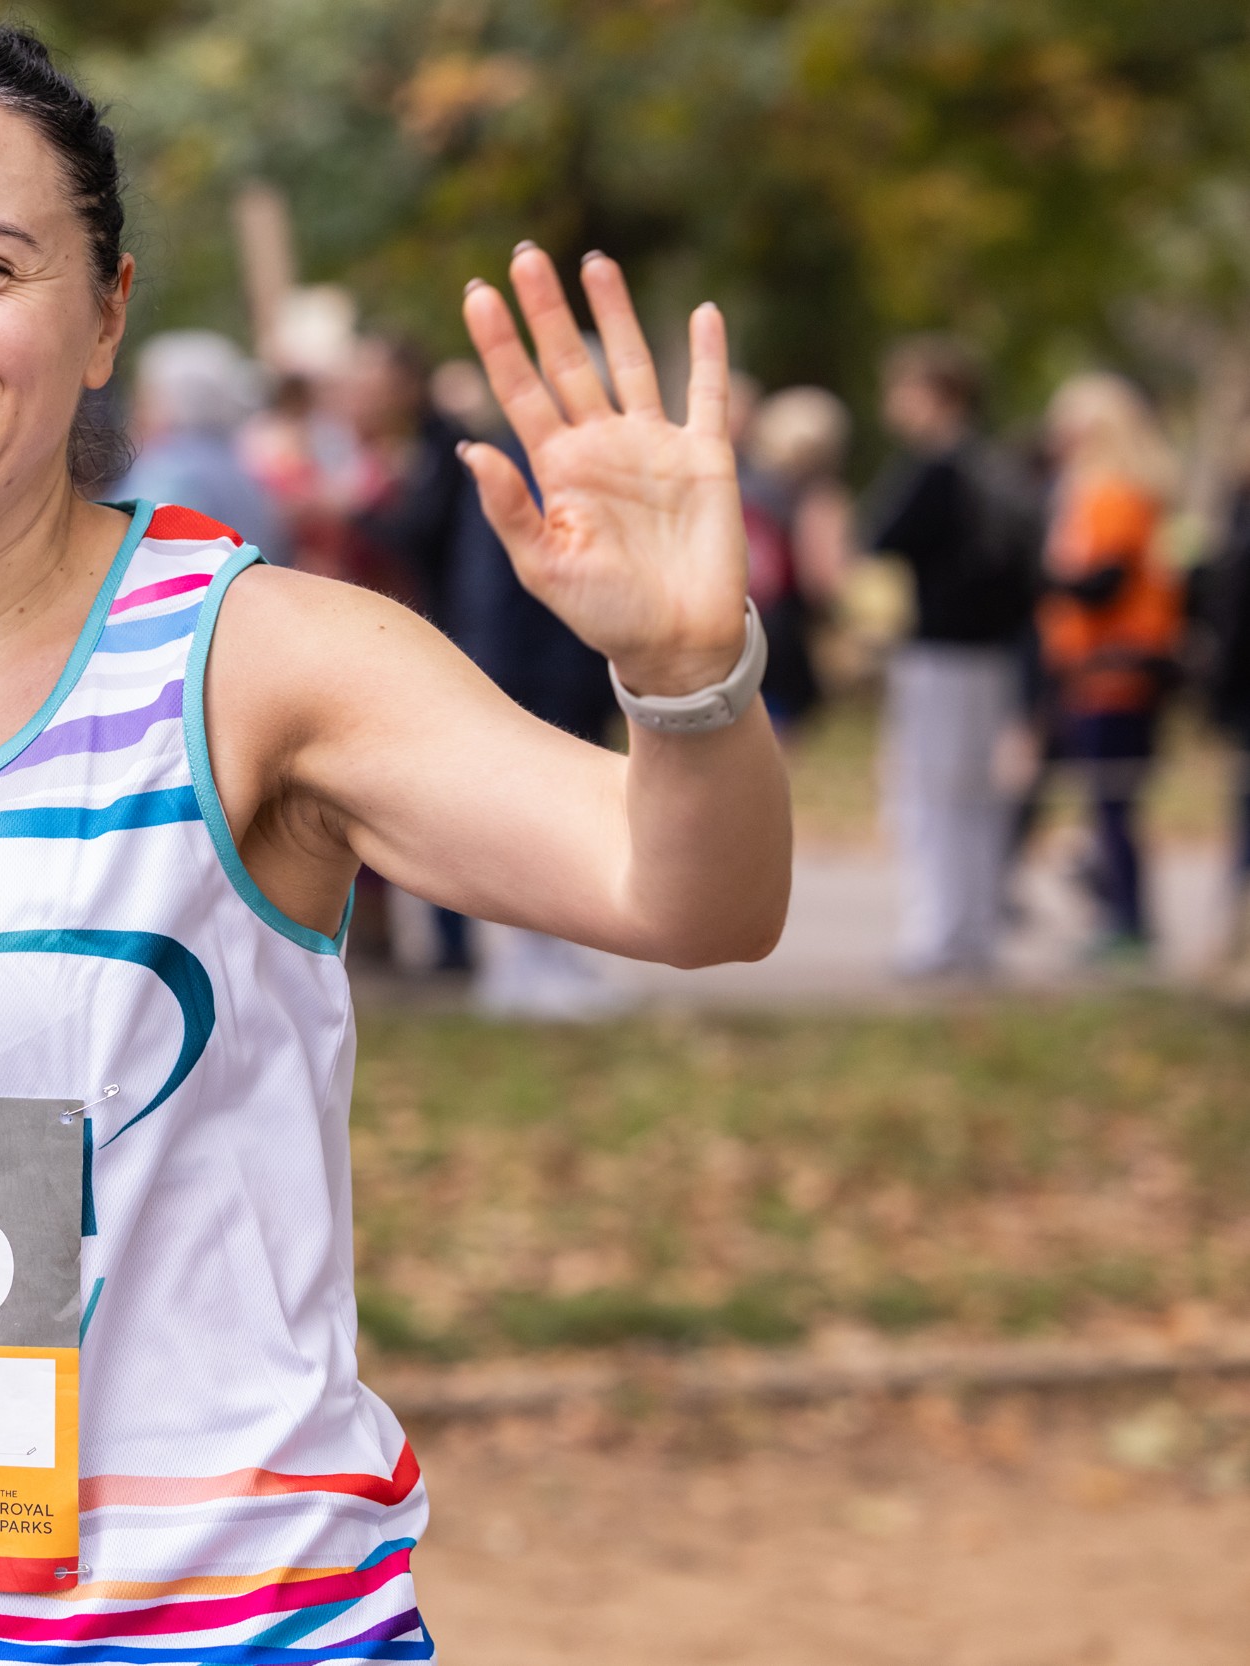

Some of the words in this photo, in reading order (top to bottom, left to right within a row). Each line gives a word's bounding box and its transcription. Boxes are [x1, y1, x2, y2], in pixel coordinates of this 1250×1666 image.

[0, 1489, 17, 1498] THE
[0, 1502, 55, 1518] ROYAL
[0, 1520, 53, 1535] PARKS
